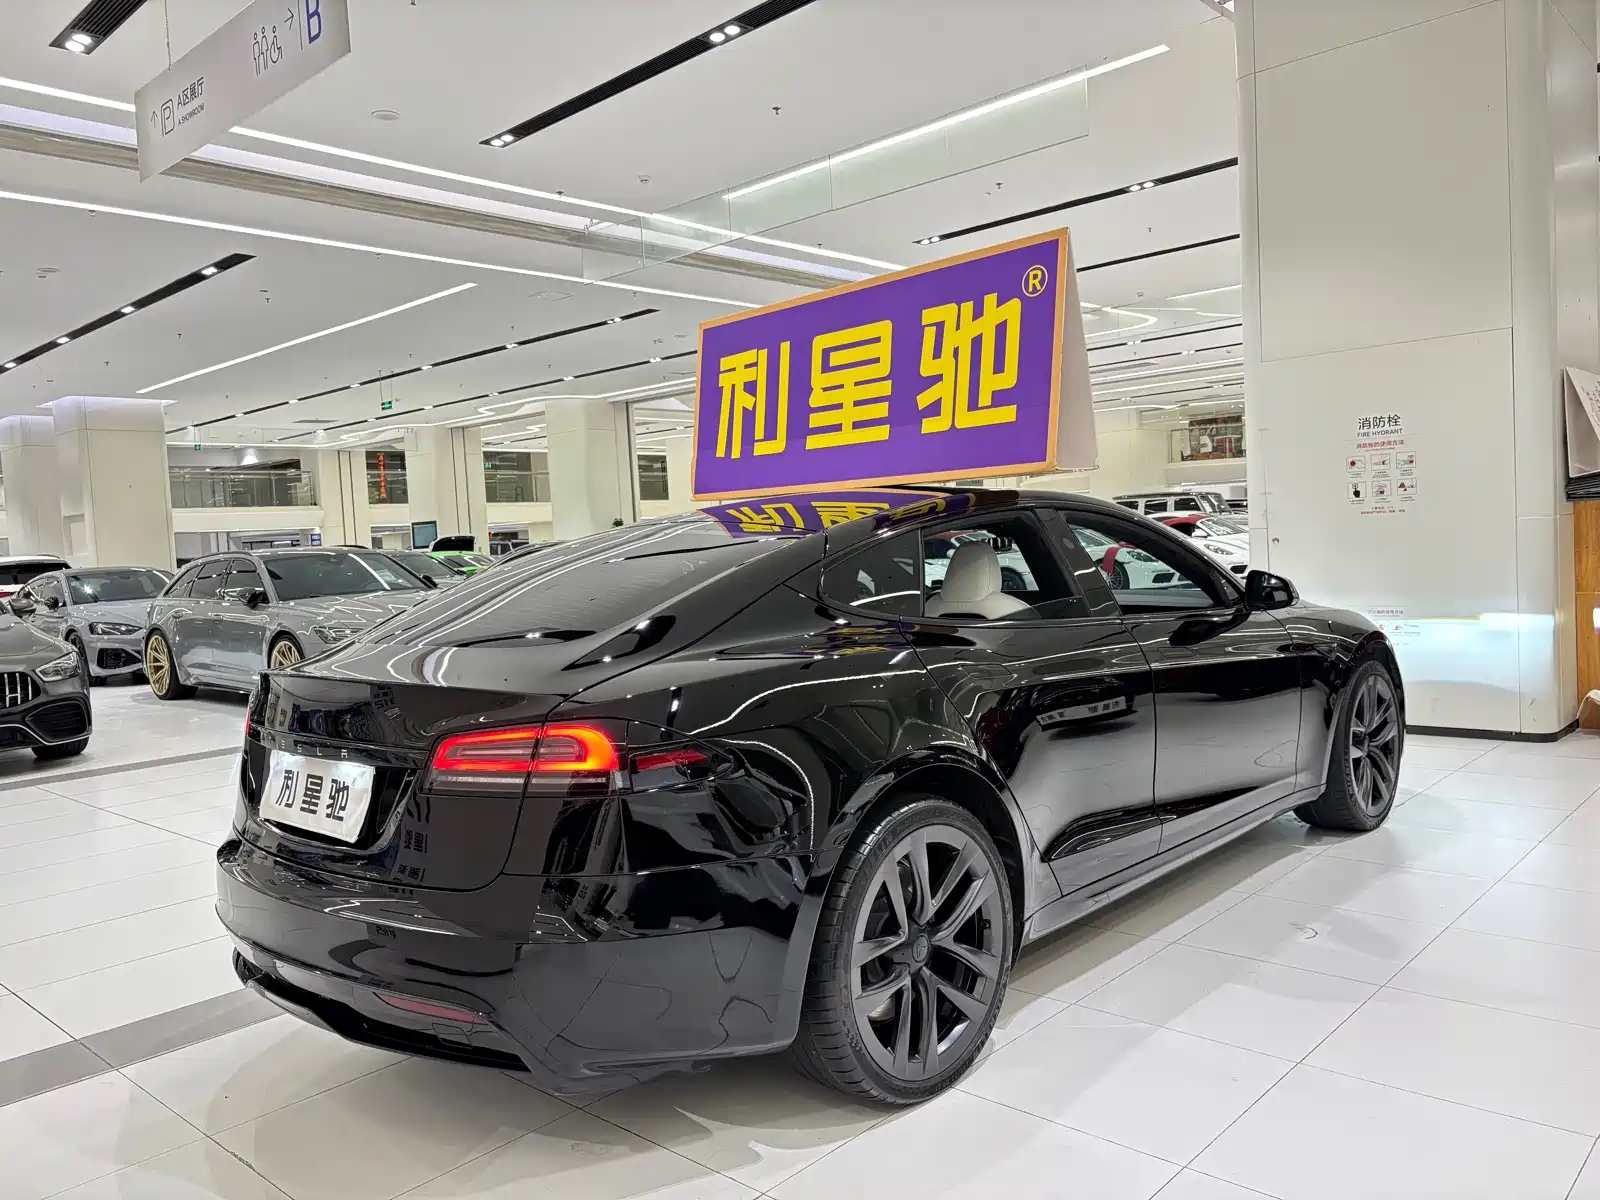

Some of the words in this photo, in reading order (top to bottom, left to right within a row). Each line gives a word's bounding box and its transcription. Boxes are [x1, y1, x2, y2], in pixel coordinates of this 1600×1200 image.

[305, 0, 322, 45] B
[176, 76, 205, 111] A区展厅
[714, 292, 1023, 460] 利星驰
[1357, 413, 1402, 431] 消防栓
[1371, 428, 1404, 437] HYDRANT
[275, 769, 350, 822] 利星驰
